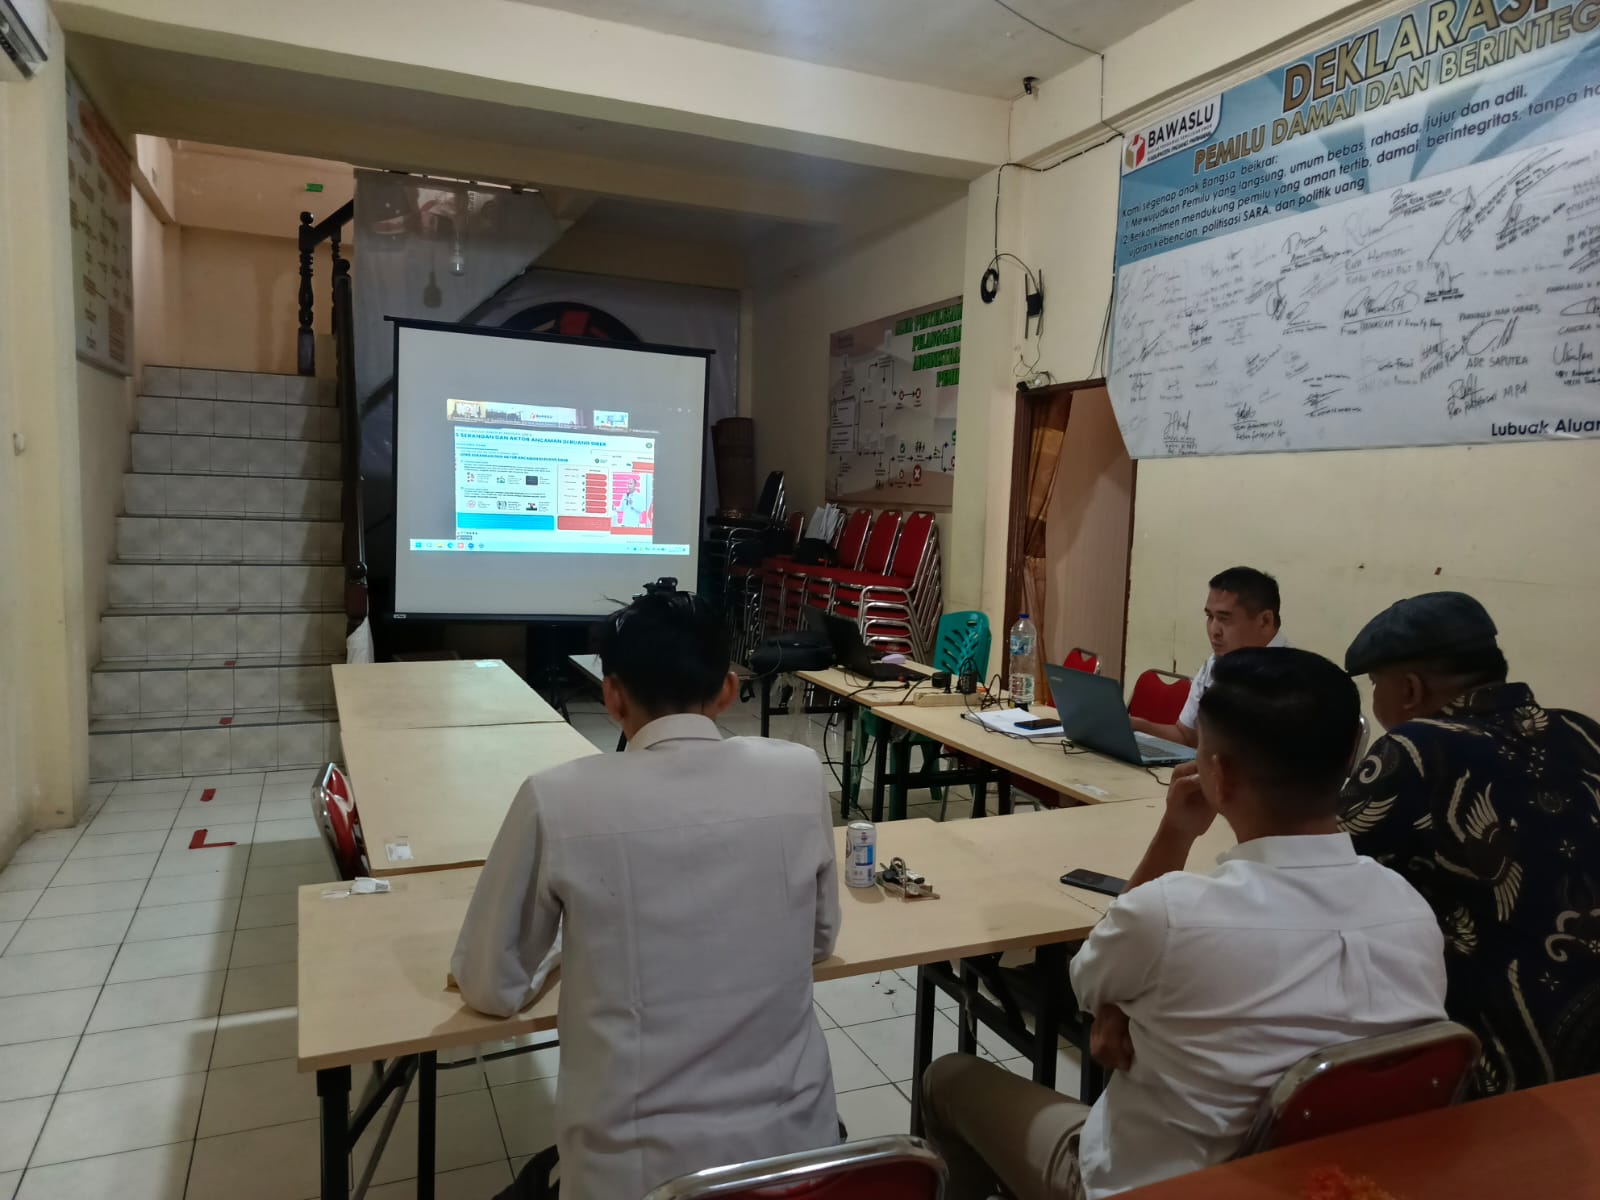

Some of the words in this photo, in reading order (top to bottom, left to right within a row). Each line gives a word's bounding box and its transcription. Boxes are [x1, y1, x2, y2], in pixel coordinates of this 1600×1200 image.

[1131, 204, 1180, 227] Mewujudkan
[1182, 192, 1210, 209] Pemilu
[1212, 183, 1236, 200] yang
[1290, 155, 1324, 174] umum
[1426, 110, 1456, 132] jujur
[1460, 99, 1490, 118] dan
[1494, 84, 1528, 106] adil.
[1148, 104, 1214, 148] BAWASLU
[1193, 124, 1265, 175] PEMILU
[1271, 89, 1357, 147] DAMAI
[1364, 60, 1430, 112] DAN
[1130, 219, 1180, 242] Berkomitmen
[1182, 201, 1235, 225] mendukung
[1237, 189, 1272, 212] pemilu
[1273, 180, 1300, 199] yang
[1303, 168, 1336, 187] aman
[1528, 92, 1577, 116] tanpa
[1143, 192, 1176, 210] segenap
[1178, 182, 1199, 197] anak
[1129, 243, 1152, 259] ujaran
[1202, 213, 1241, 236] politisasi
[1275, 197, 1296, 212] dan
[1299, 187, 1331, 208] politik
[1335, 177, 1365, 195] uang
[1491, 419, 1549, 437] Lubuak
